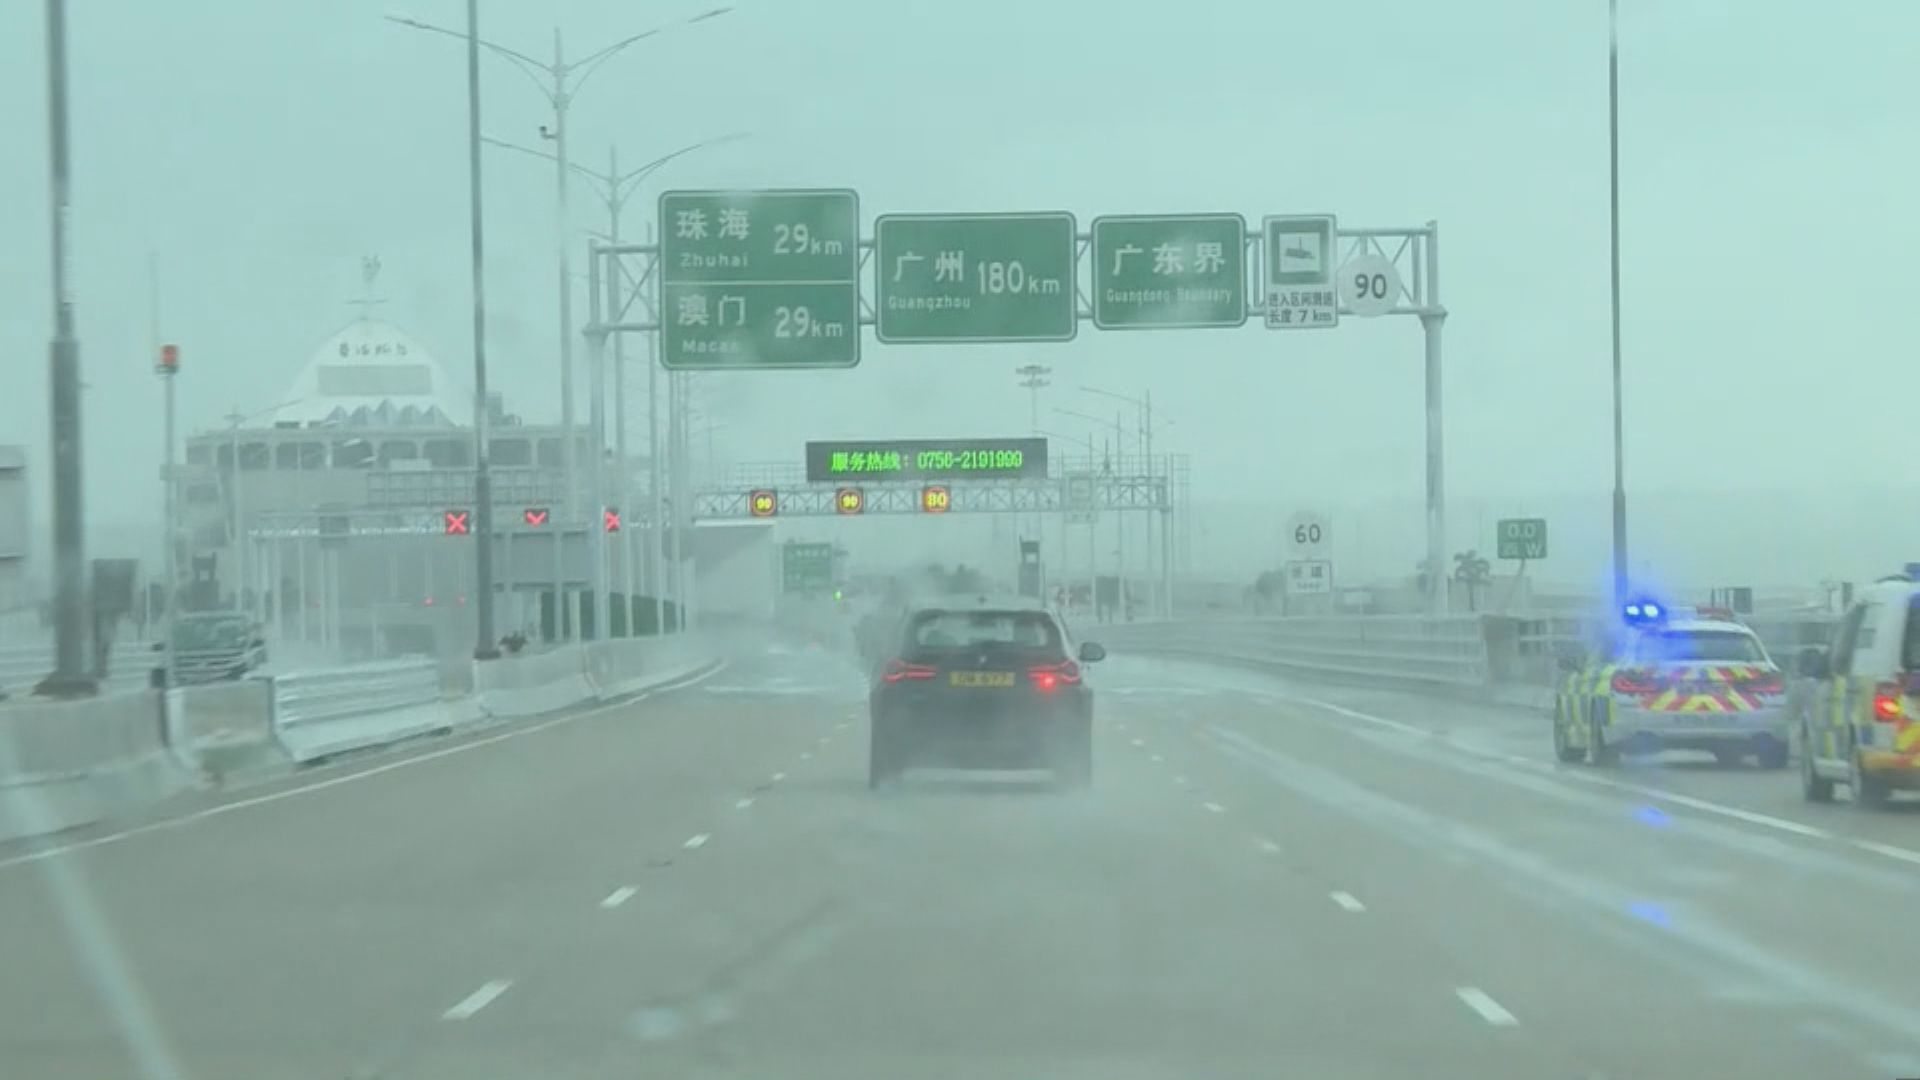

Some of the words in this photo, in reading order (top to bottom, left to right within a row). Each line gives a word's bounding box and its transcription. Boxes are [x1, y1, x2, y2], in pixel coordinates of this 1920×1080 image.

[676, 208, 750, 240] 珠海
[680, 252, 748, 268] Zhuhai
[893, 250, 965, 282] 广州
[1112, 241, 1226, 277] 广东界
[1354, 273, 1387, 299] 90
[678, 294, 746, 326] 澳门
[888, 295, 971, 312] Guangzhou
[1298, 309, 1308, 322] 7
[1313, 309, 1332, 322] km
[1295, 523, 1321, 544] 60
